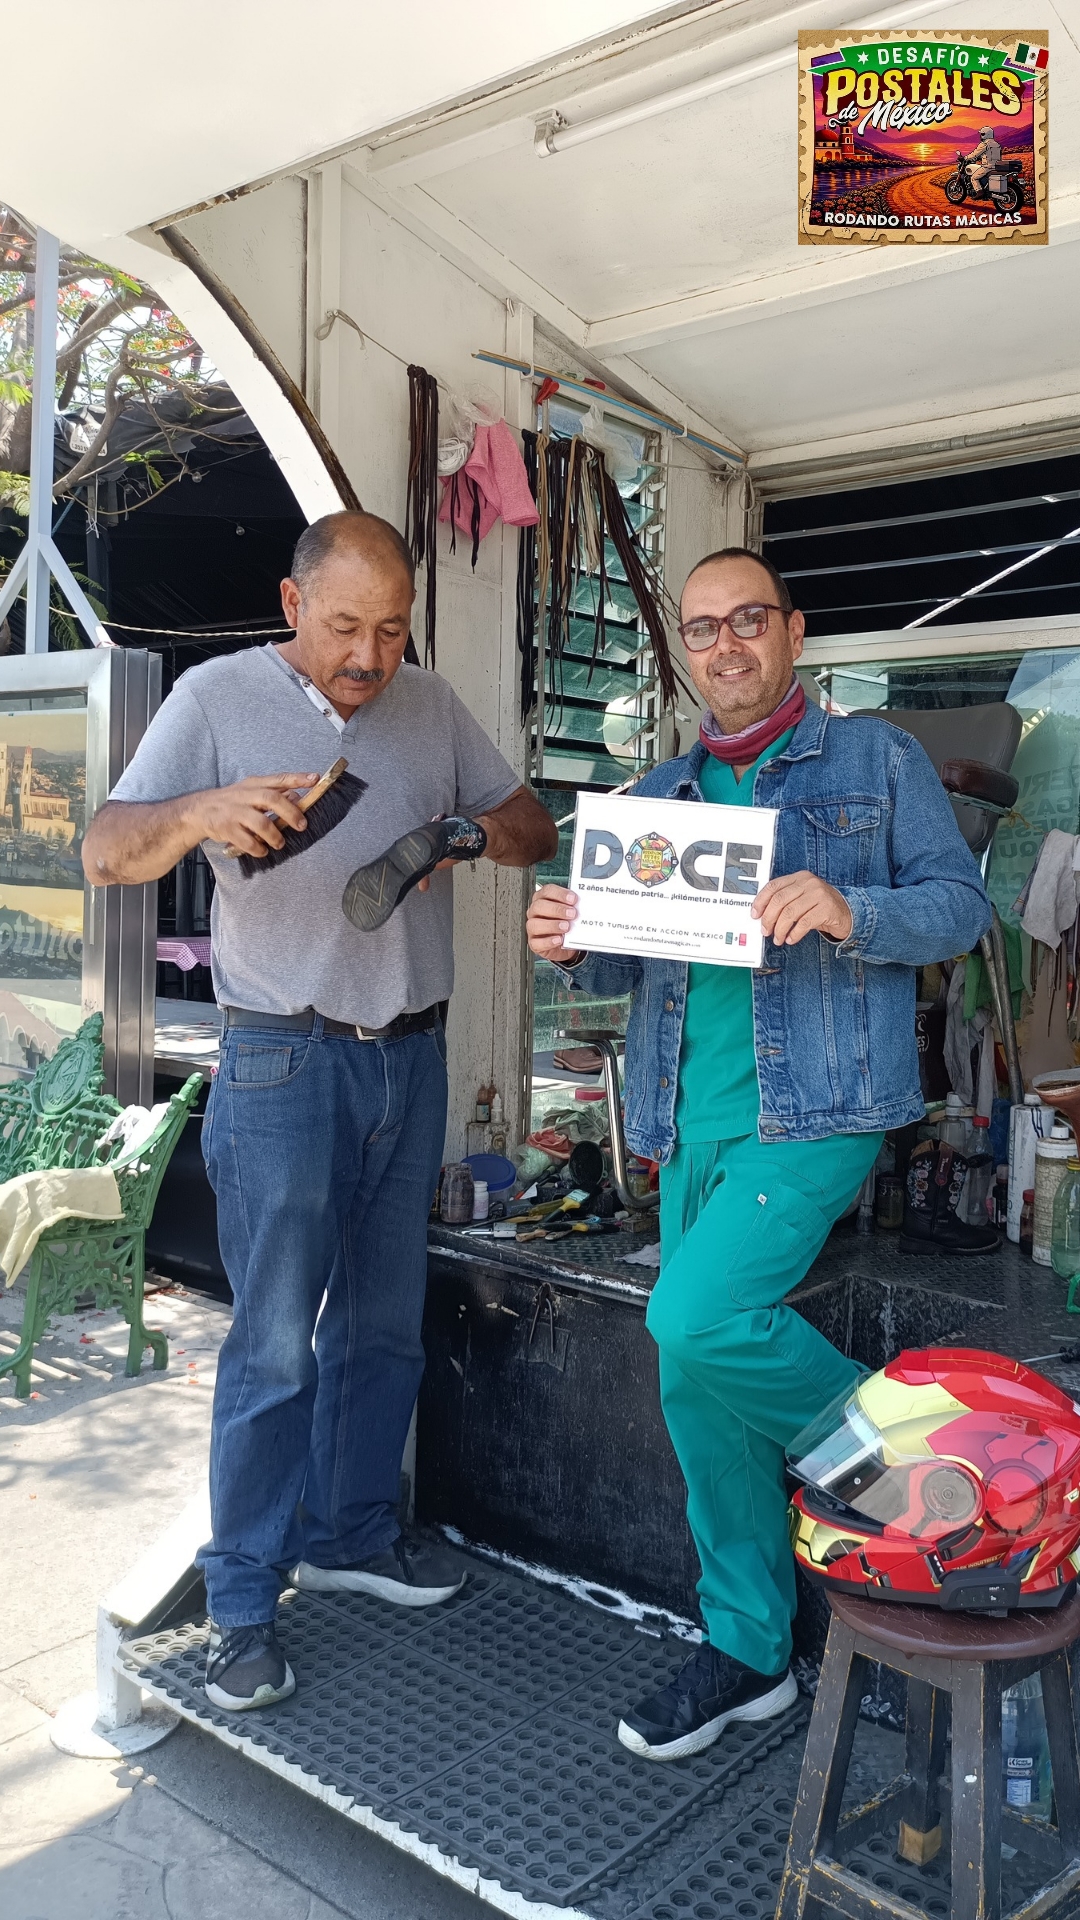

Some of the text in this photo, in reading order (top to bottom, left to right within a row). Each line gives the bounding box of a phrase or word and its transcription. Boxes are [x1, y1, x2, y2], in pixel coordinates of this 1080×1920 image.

[586, 884, 604, 892] años
[605, 886, 640, 896] haciendo
[580, 919, 604, 927] MOTO
[607, 922, 643, 931] TURISMO
[692, 931, 724, 940] MEXICO
